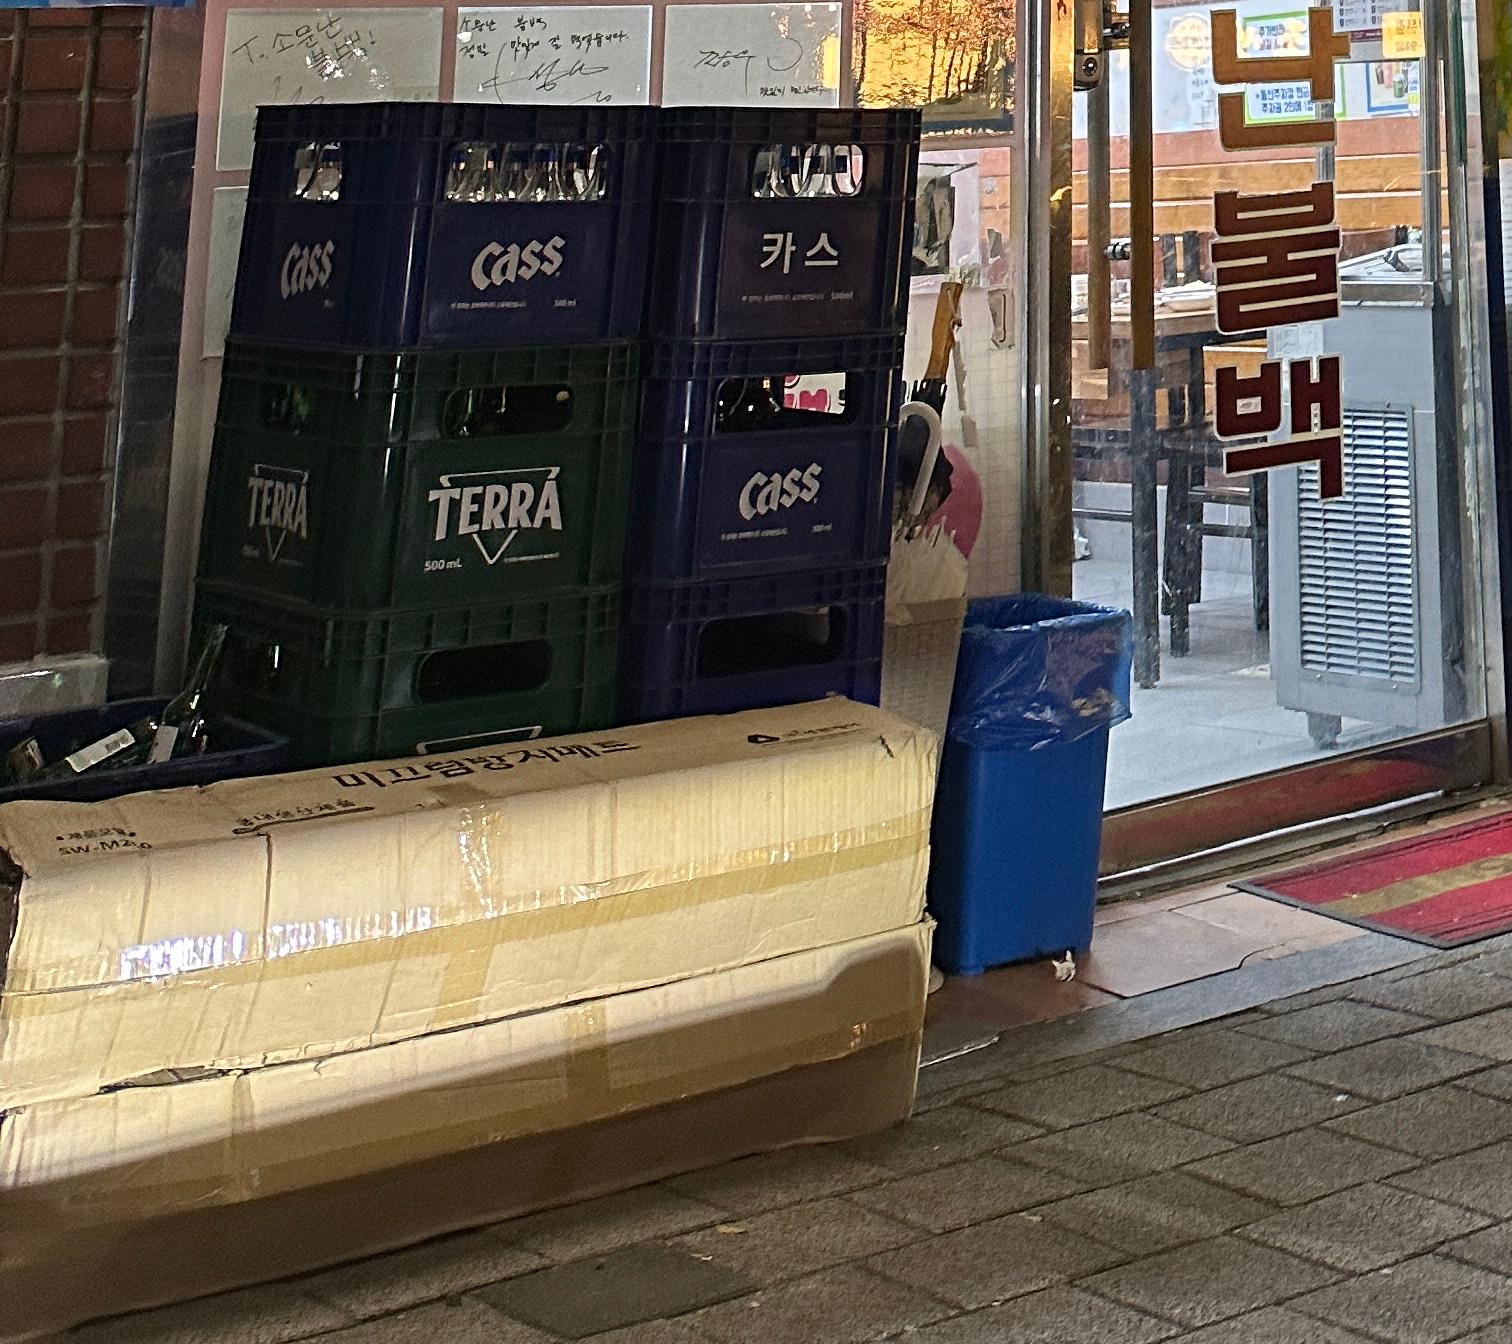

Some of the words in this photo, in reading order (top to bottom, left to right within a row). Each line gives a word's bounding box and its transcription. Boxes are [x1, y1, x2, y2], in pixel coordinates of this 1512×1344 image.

[280, 238, 334, 301] Cass
[470, 234, 566, 292] Cass
[761, 231, 840, 275] 카스
[247, 476, 308, 542] TERRA
[428, 478, 563, 542] TERRA
[738, 461, 823, 521] Cass
